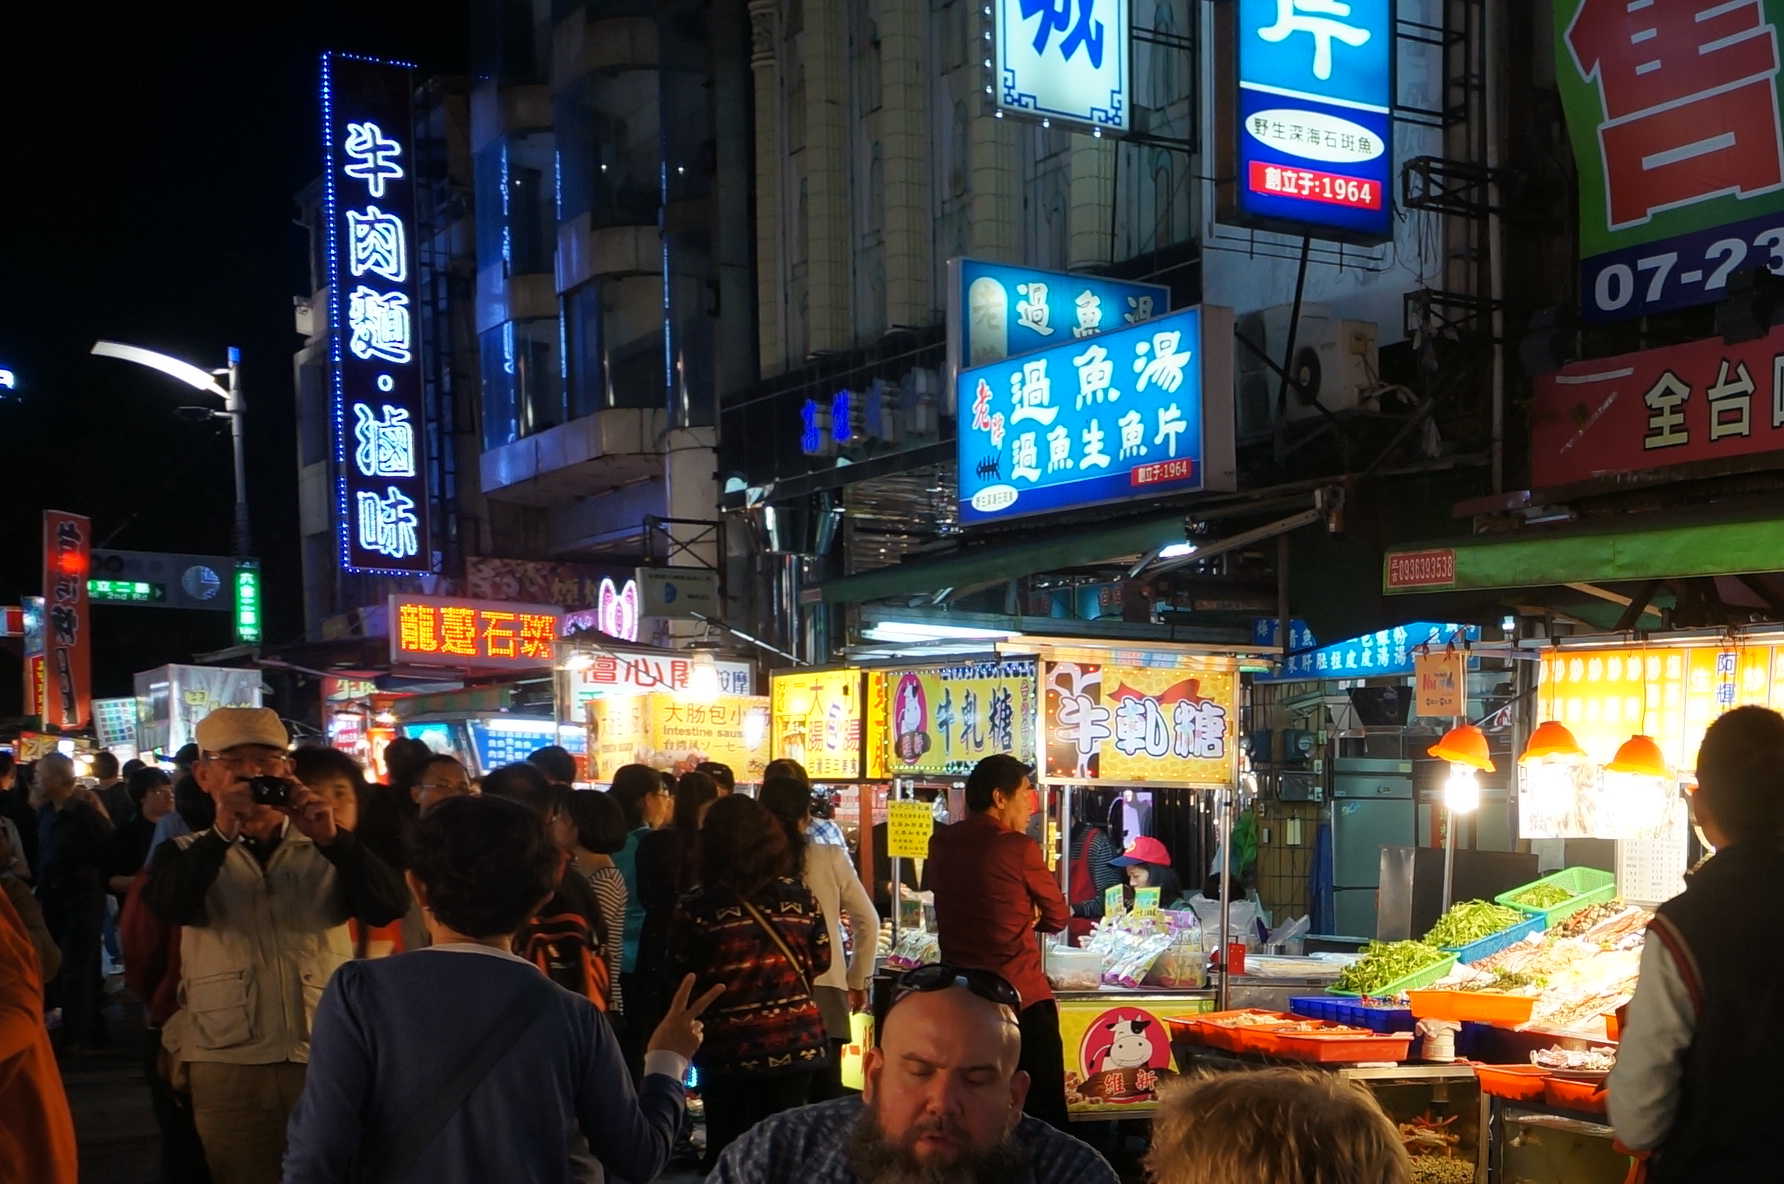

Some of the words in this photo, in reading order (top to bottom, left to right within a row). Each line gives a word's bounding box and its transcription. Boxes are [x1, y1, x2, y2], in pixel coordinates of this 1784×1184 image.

[1253, 116, 1373, 154] 野生深海石斑魚
[1010, 330, 1192, 427] 過魚湯
[1011, 402, 1188, 483] 過魚生魚片
[1400, 555, 1453, 581] 0936393538
[663, 725, 714, 738] Intestine
[1056, 695, 1227, 759] 牛軋糖
[1104, 1069, 1158, 1095] 維新
